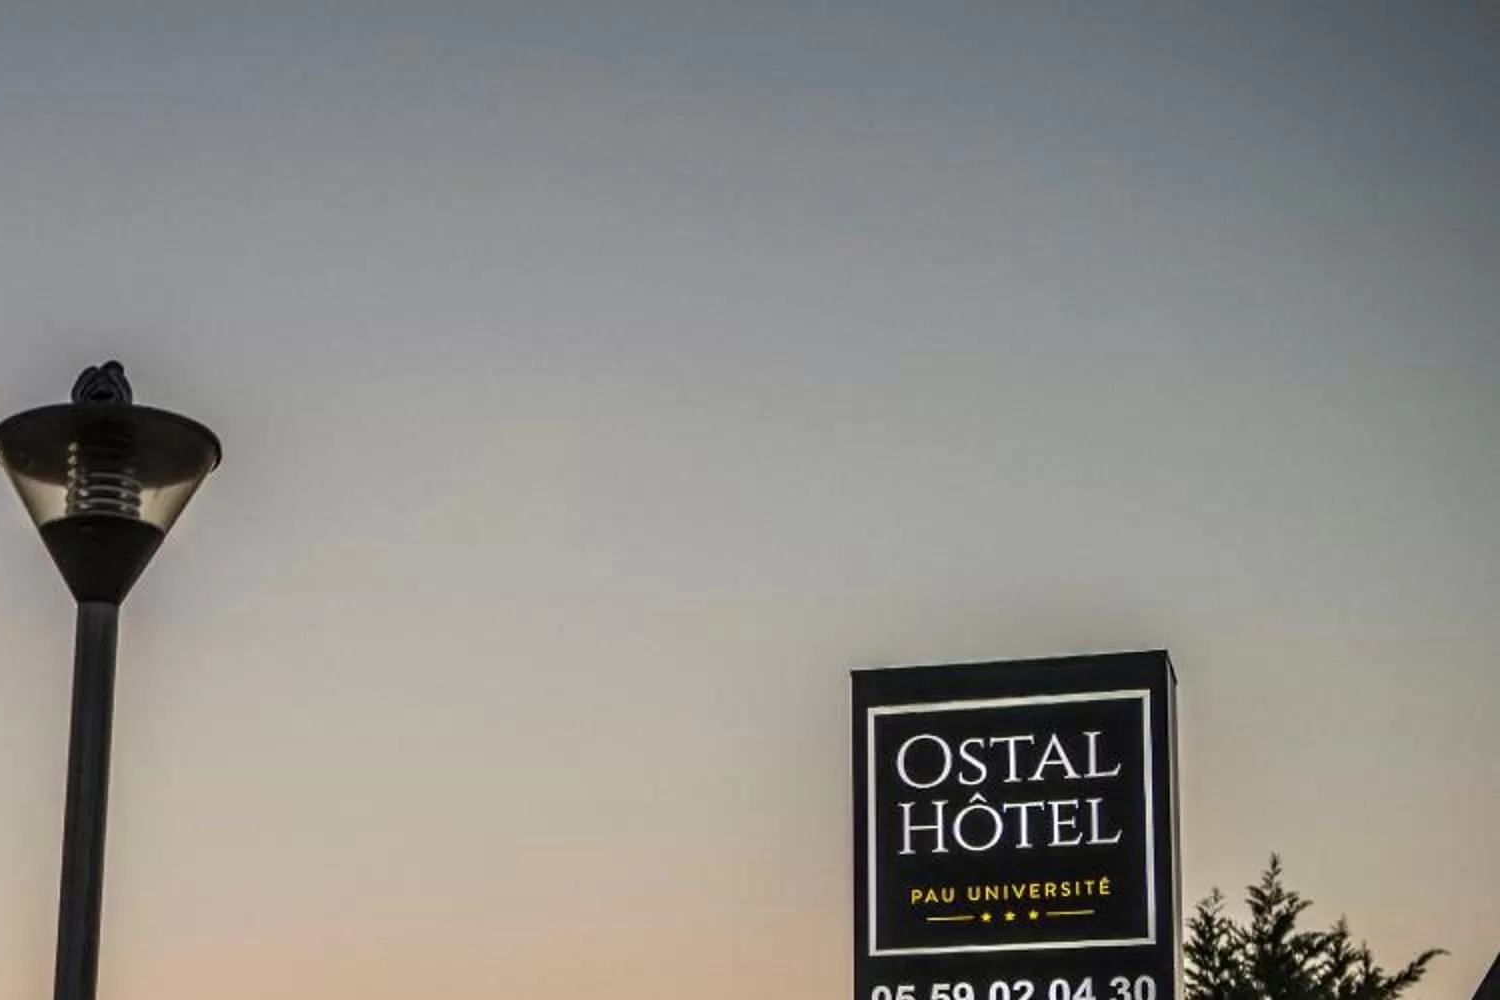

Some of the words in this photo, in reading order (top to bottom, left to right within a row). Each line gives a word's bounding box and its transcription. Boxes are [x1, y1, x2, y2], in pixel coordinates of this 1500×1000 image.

[896, 731, 1122, 789] OSTAL
[897, 791, 1123, 855] HÔTEL
[910, 887, 955, 904] PAU
[967, 876, 1112, 901] UNIVERSITÉ
